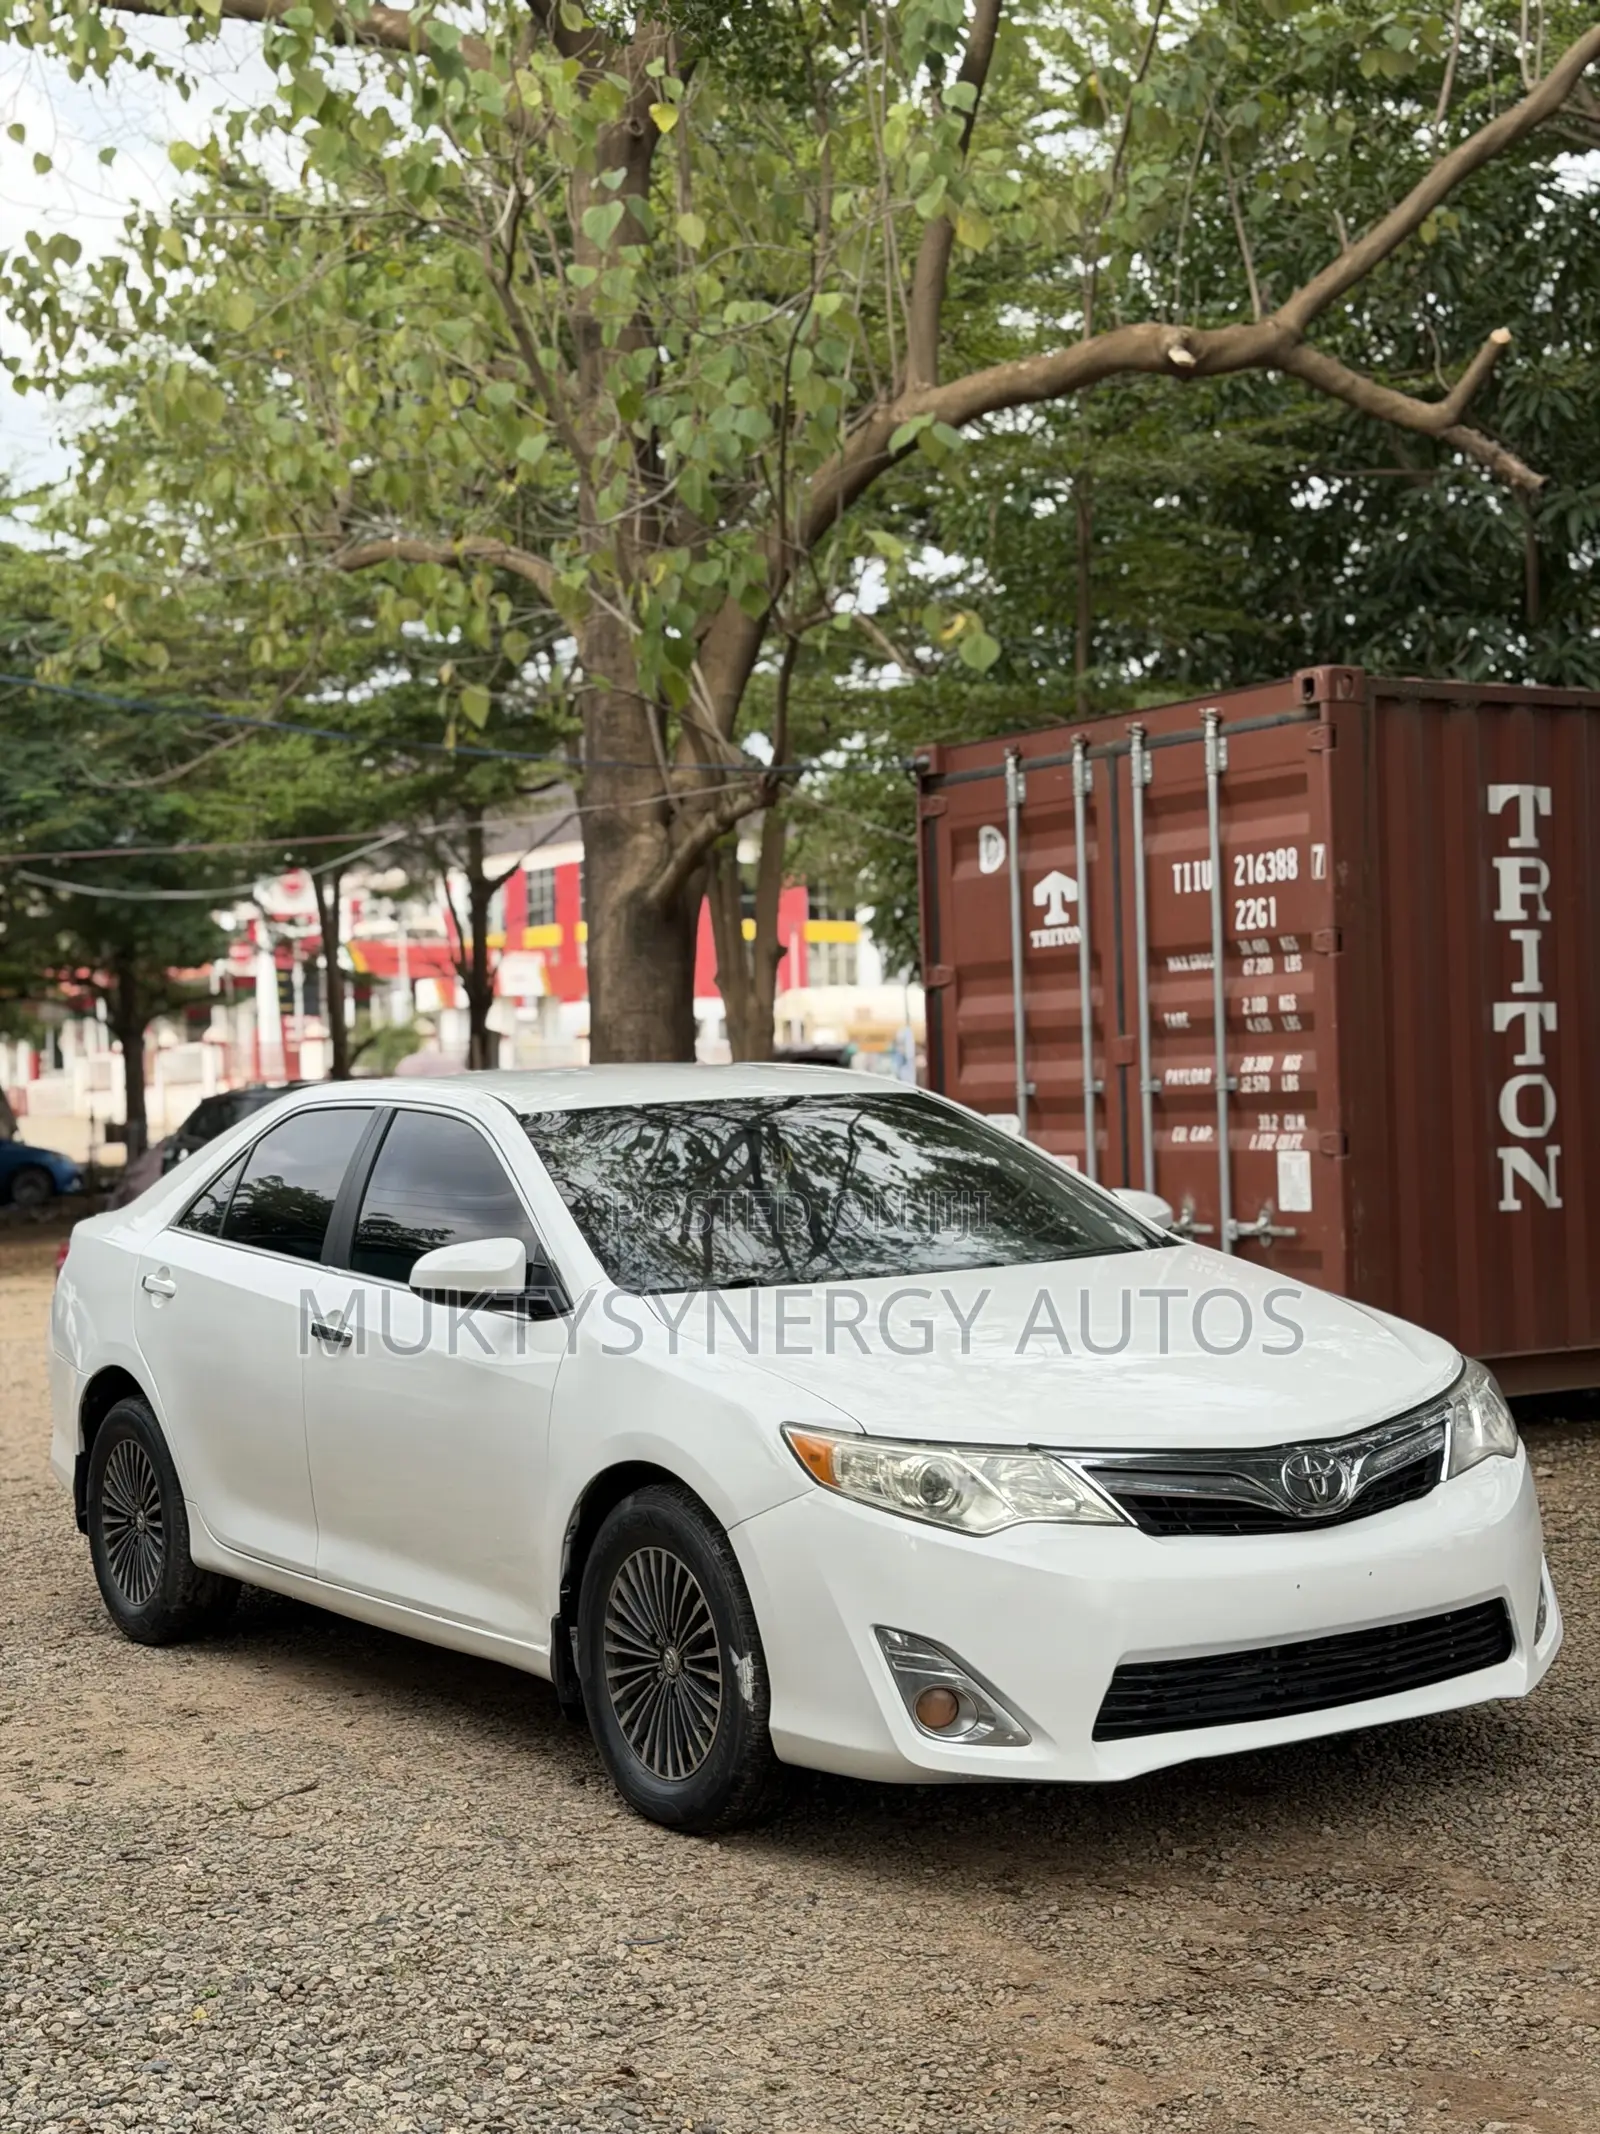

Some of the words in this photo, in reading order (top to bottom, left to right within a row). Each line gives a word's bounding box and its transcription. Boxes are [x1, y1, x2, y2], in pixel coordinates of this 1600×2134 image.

[1172, 859, 1213, 894] TIIU
[1234, 846, 1298, 887] 216388
[1311, 843, 1326, 880] 7
[1235, 896, 1277, 931] 22G1
[1284, 953, 1303, 973] LBS
[1487, 783, 1562, 1213] TRITON
[1165, 1067, 1212, 1085] PAYLOAD
[1281, 1074, 1300, 1092] LBS
